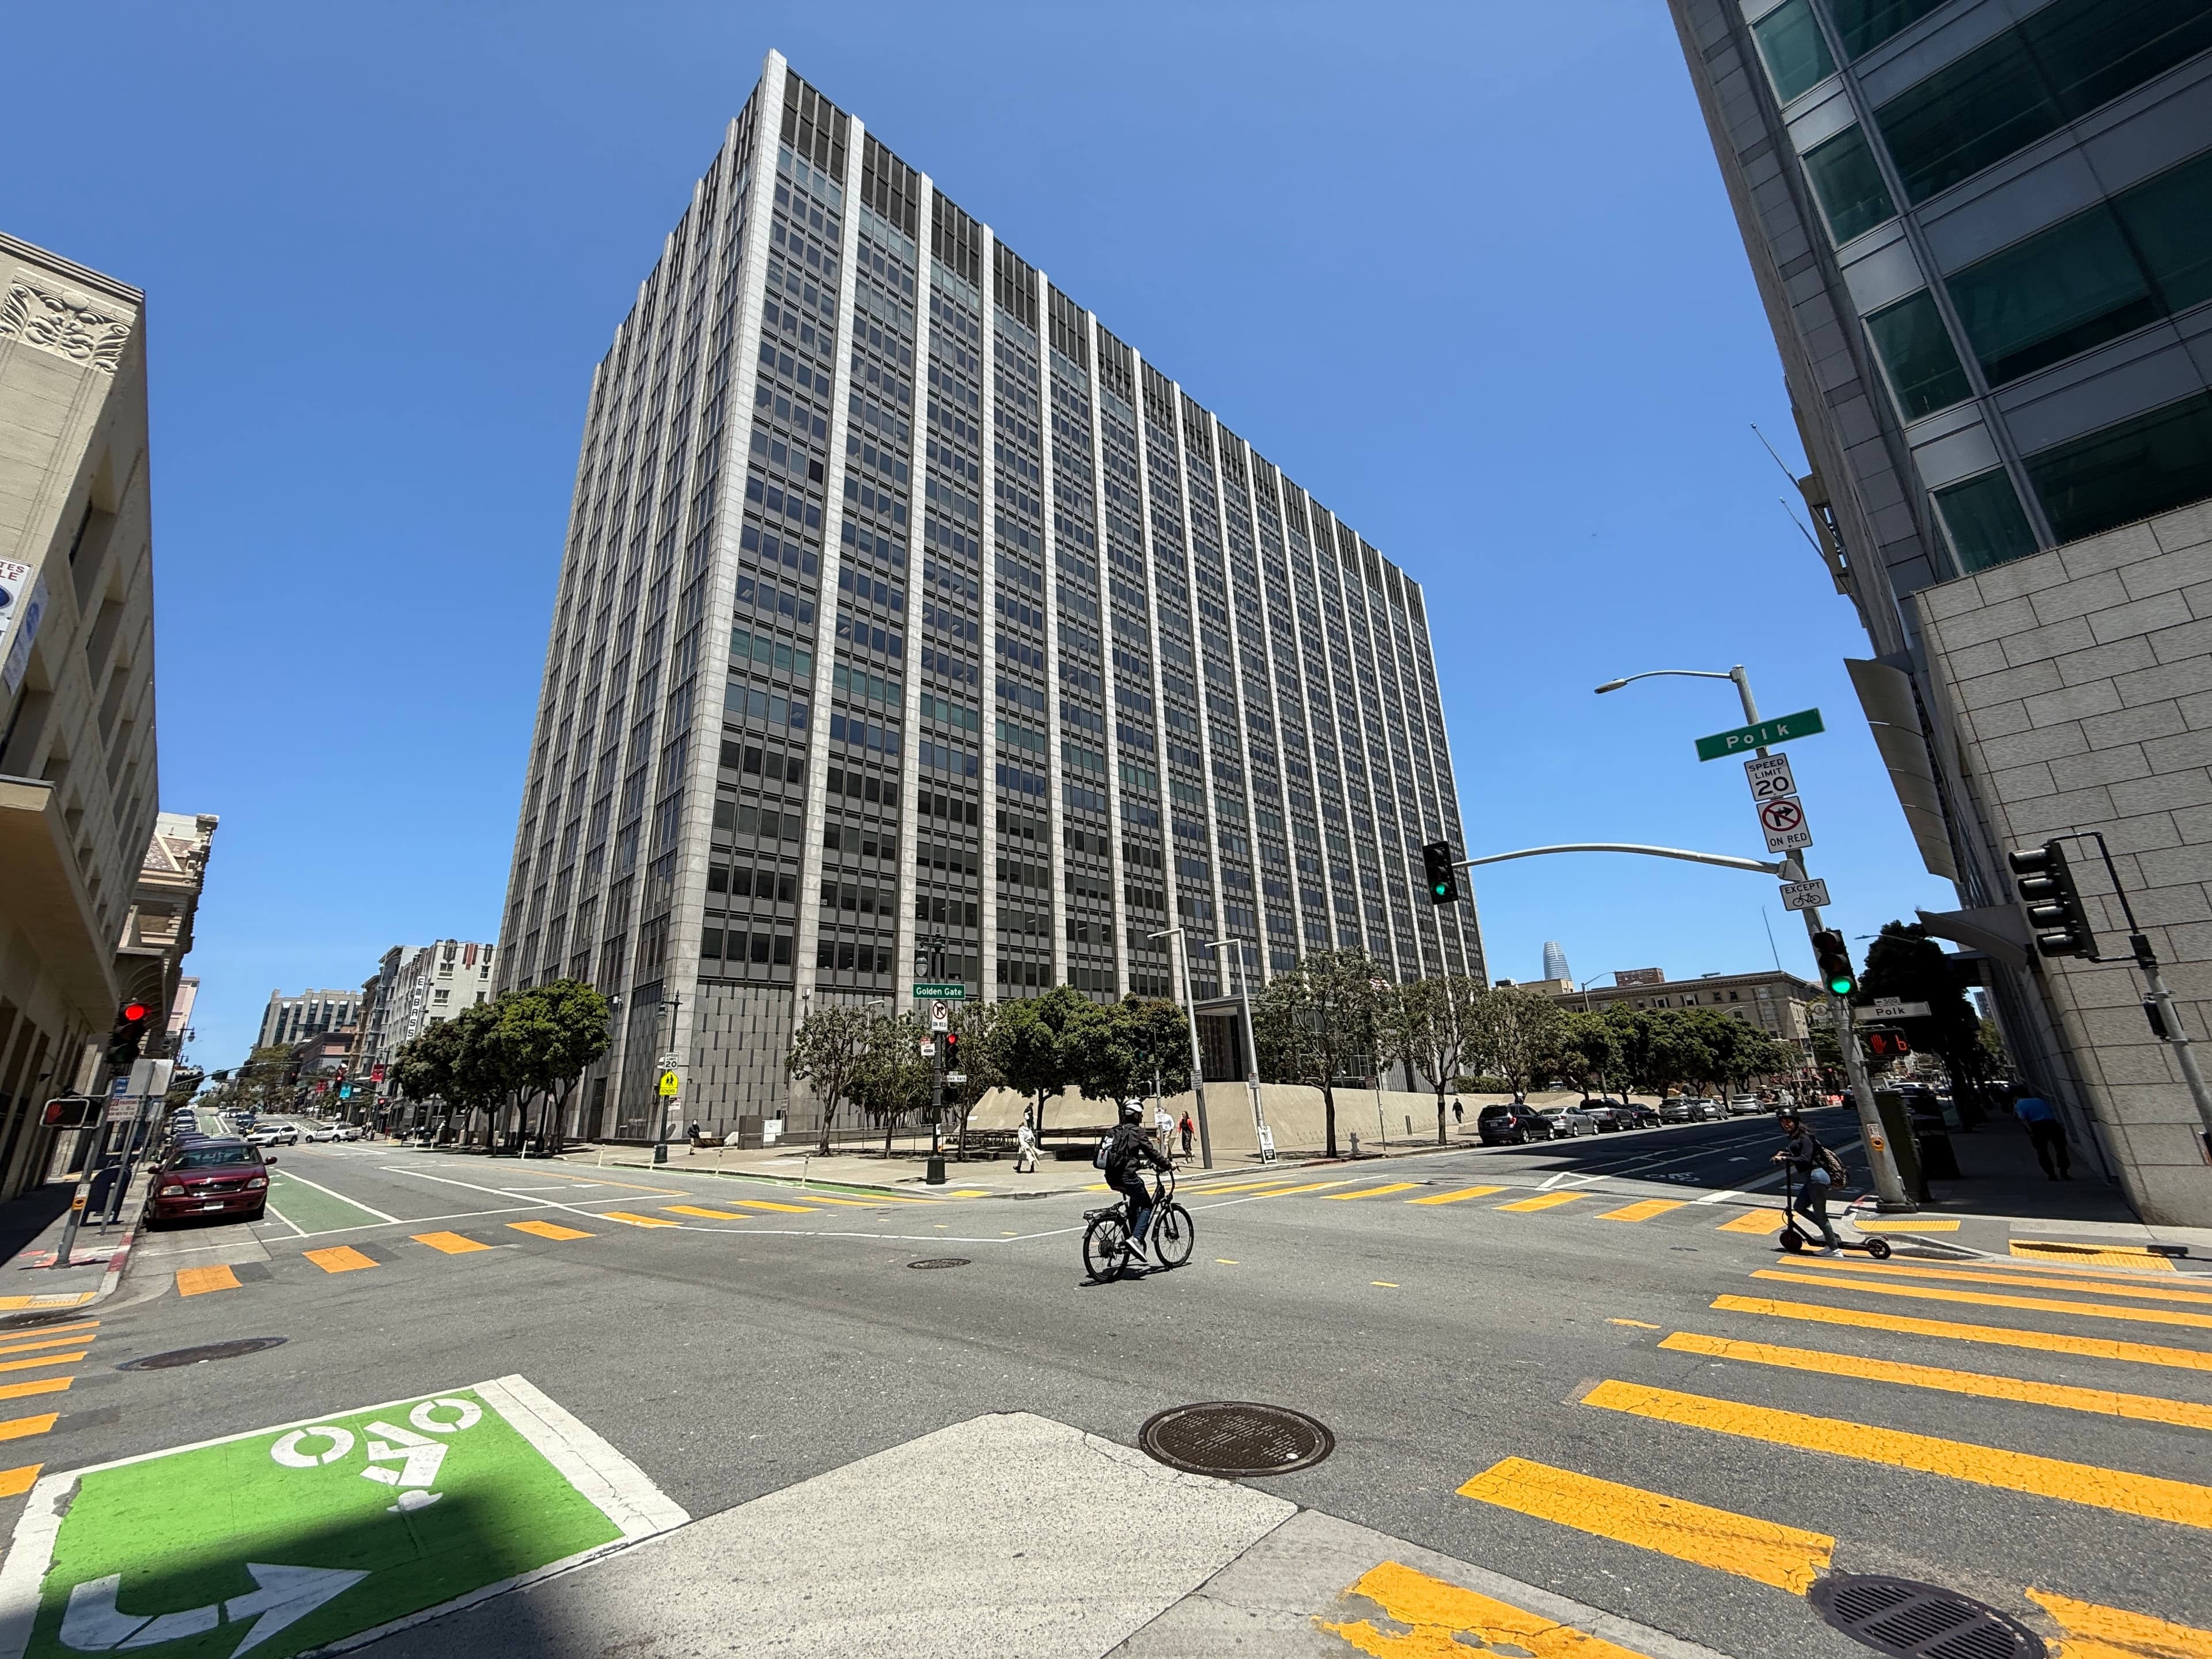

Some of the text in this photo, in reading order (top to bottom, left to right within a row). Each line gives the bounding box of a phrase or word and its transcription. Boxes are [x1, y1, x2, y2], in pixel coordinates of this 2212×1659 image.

[1726, 724, 1790, 749] Polk
[1749, 759, 1784, 772] SPEED
[1755, 767, 1782, 779] LIMIT
[1755, 776, 1789, 796] 20
[1770, 832, 1807, 847] ON RED
[1785, 882, 1820, 894] EXCEPT
[916, 987, 962, 996] Golden Gate
[407, 978, 425, 1037] EMBASS
[1876, 1007, 1906, 1016] Polk
